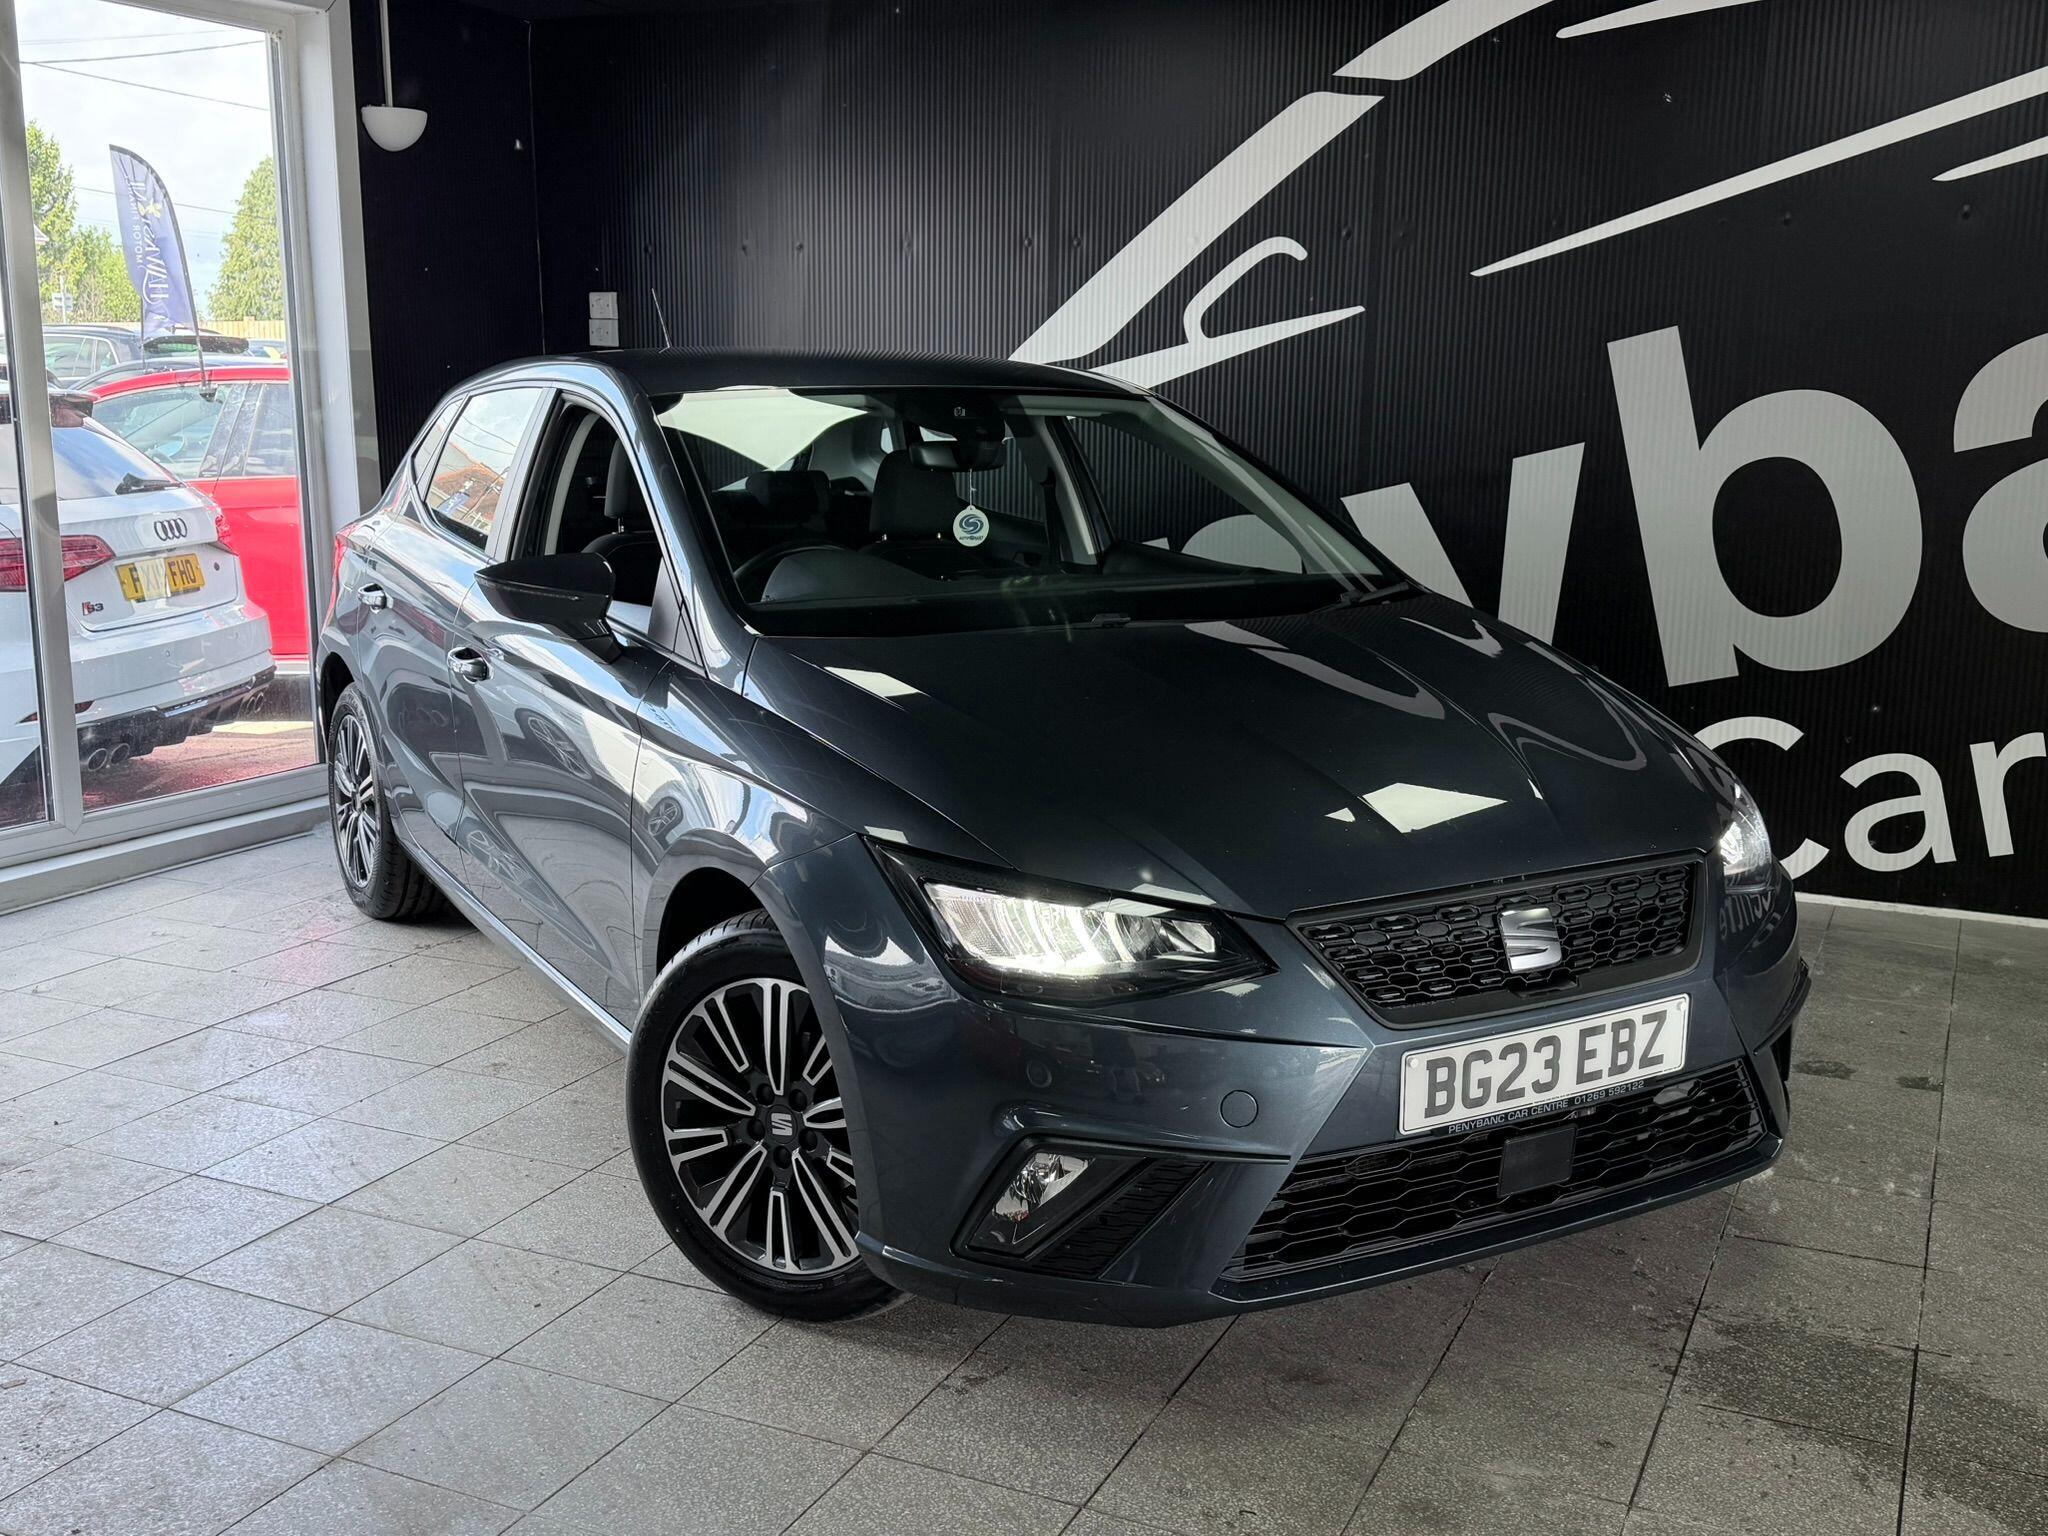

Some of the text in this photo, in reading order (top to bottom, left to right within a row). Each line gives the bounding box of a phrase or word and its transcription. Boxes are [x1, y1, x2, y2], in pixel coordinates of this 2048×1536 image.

[1424, 1010, 1667, 1118] BG23 EBZ
[1448, 1114, 1505, 1134] PENYBANC
[1508, 1109, 1528, 1121] CAR
[1531, 1099, 1568, 1115] CENTRE
[1574, 1090, 1606, 1105] 01269
[1608, 1080, 1645, 1096] 592122
